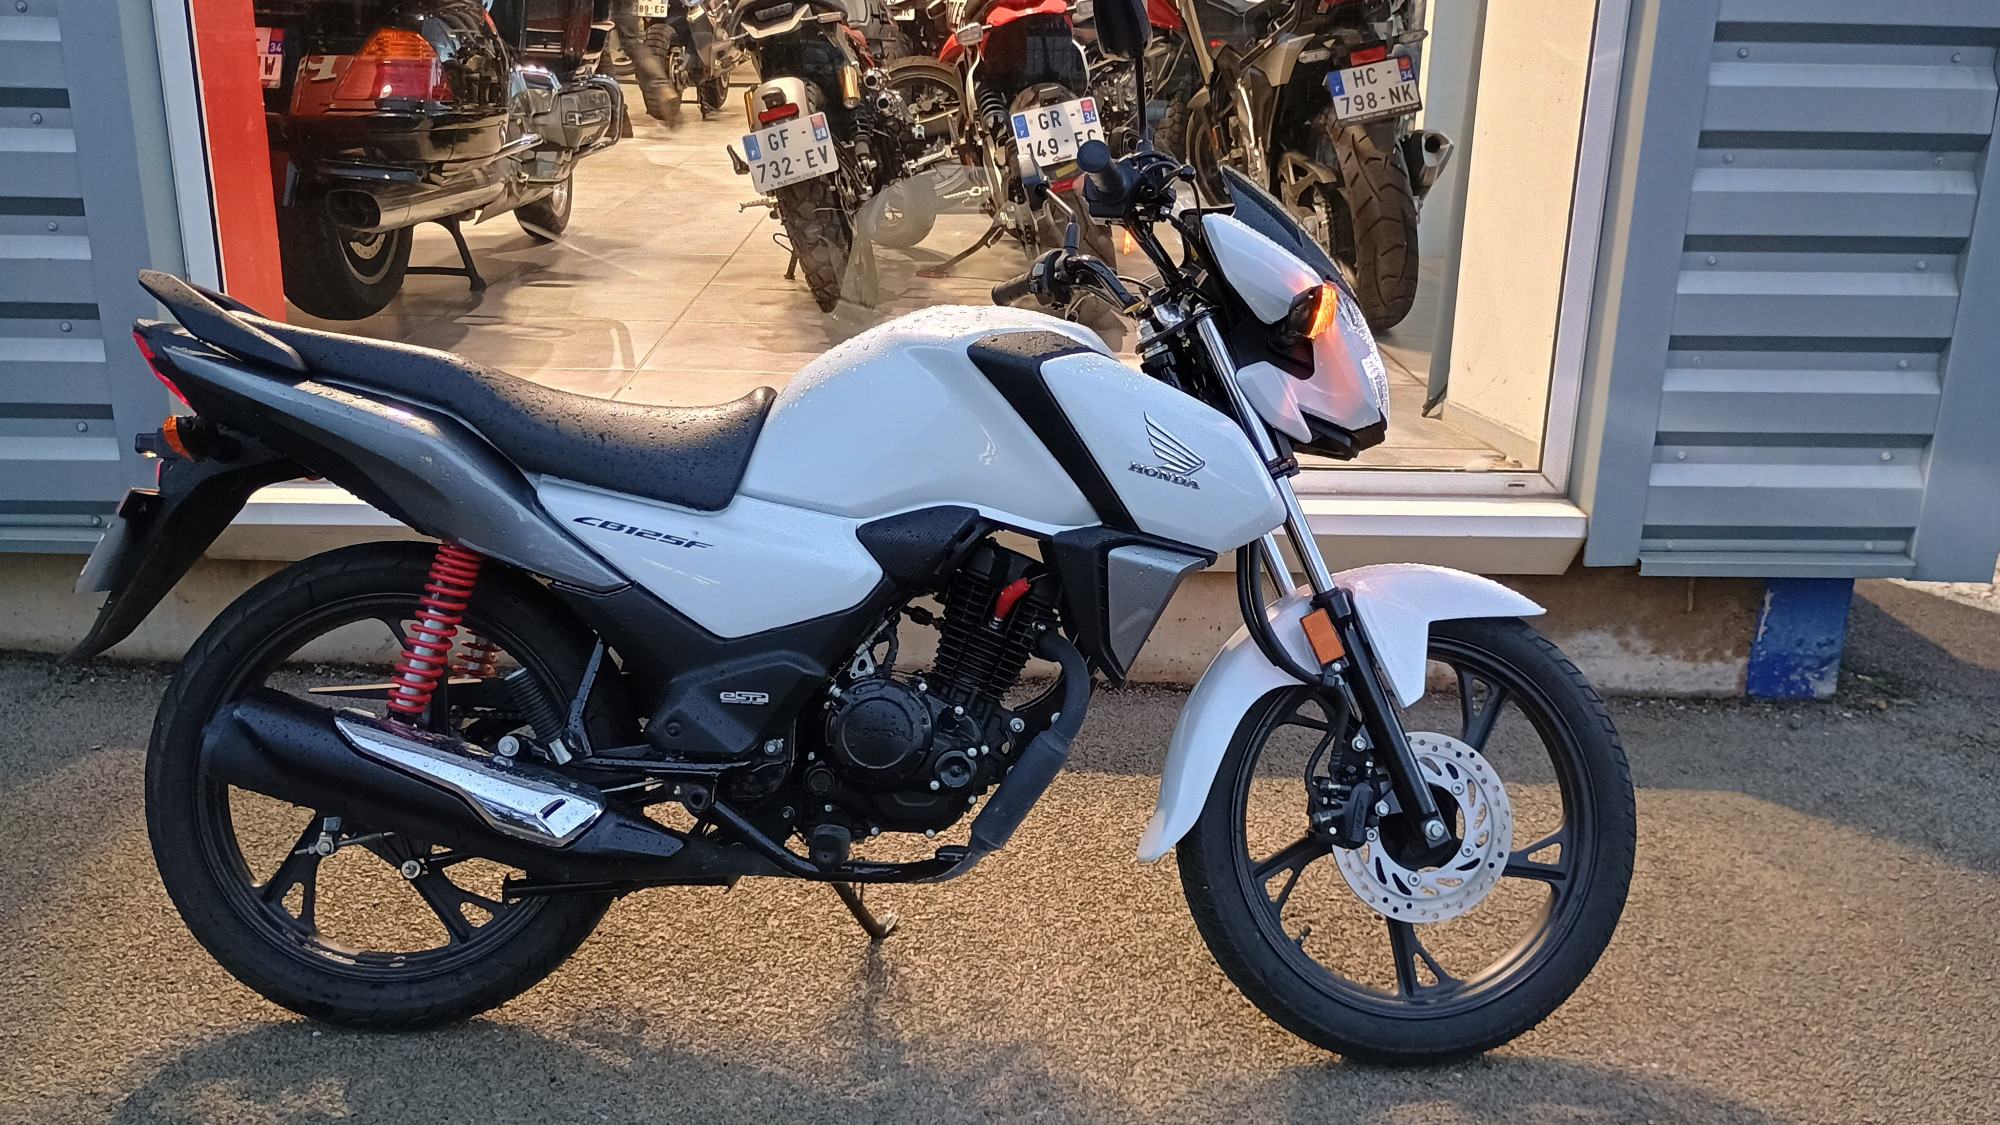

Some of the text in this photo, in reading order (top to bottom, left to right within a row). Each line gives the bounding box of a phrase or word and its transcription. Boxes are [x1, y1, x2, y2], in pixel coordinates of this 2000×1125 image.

[269, 42, 282, 53] 34
[1352, 67, 1378, 88] HC
[1400, 70, 1413, 80] 34
[1340, 84, 1414, 115] 798-NK
[1037, 109, 1062, 130] GR
[1084, 111, 1096, 122] 34
[767, 128, 789, 152] GF
[751, 150, 757, 158] F
[756, 145, 828, 184] 732-EV
[1128, 461, 1200, 491] HONDA
[572, 516, 714, 549] CB125F
